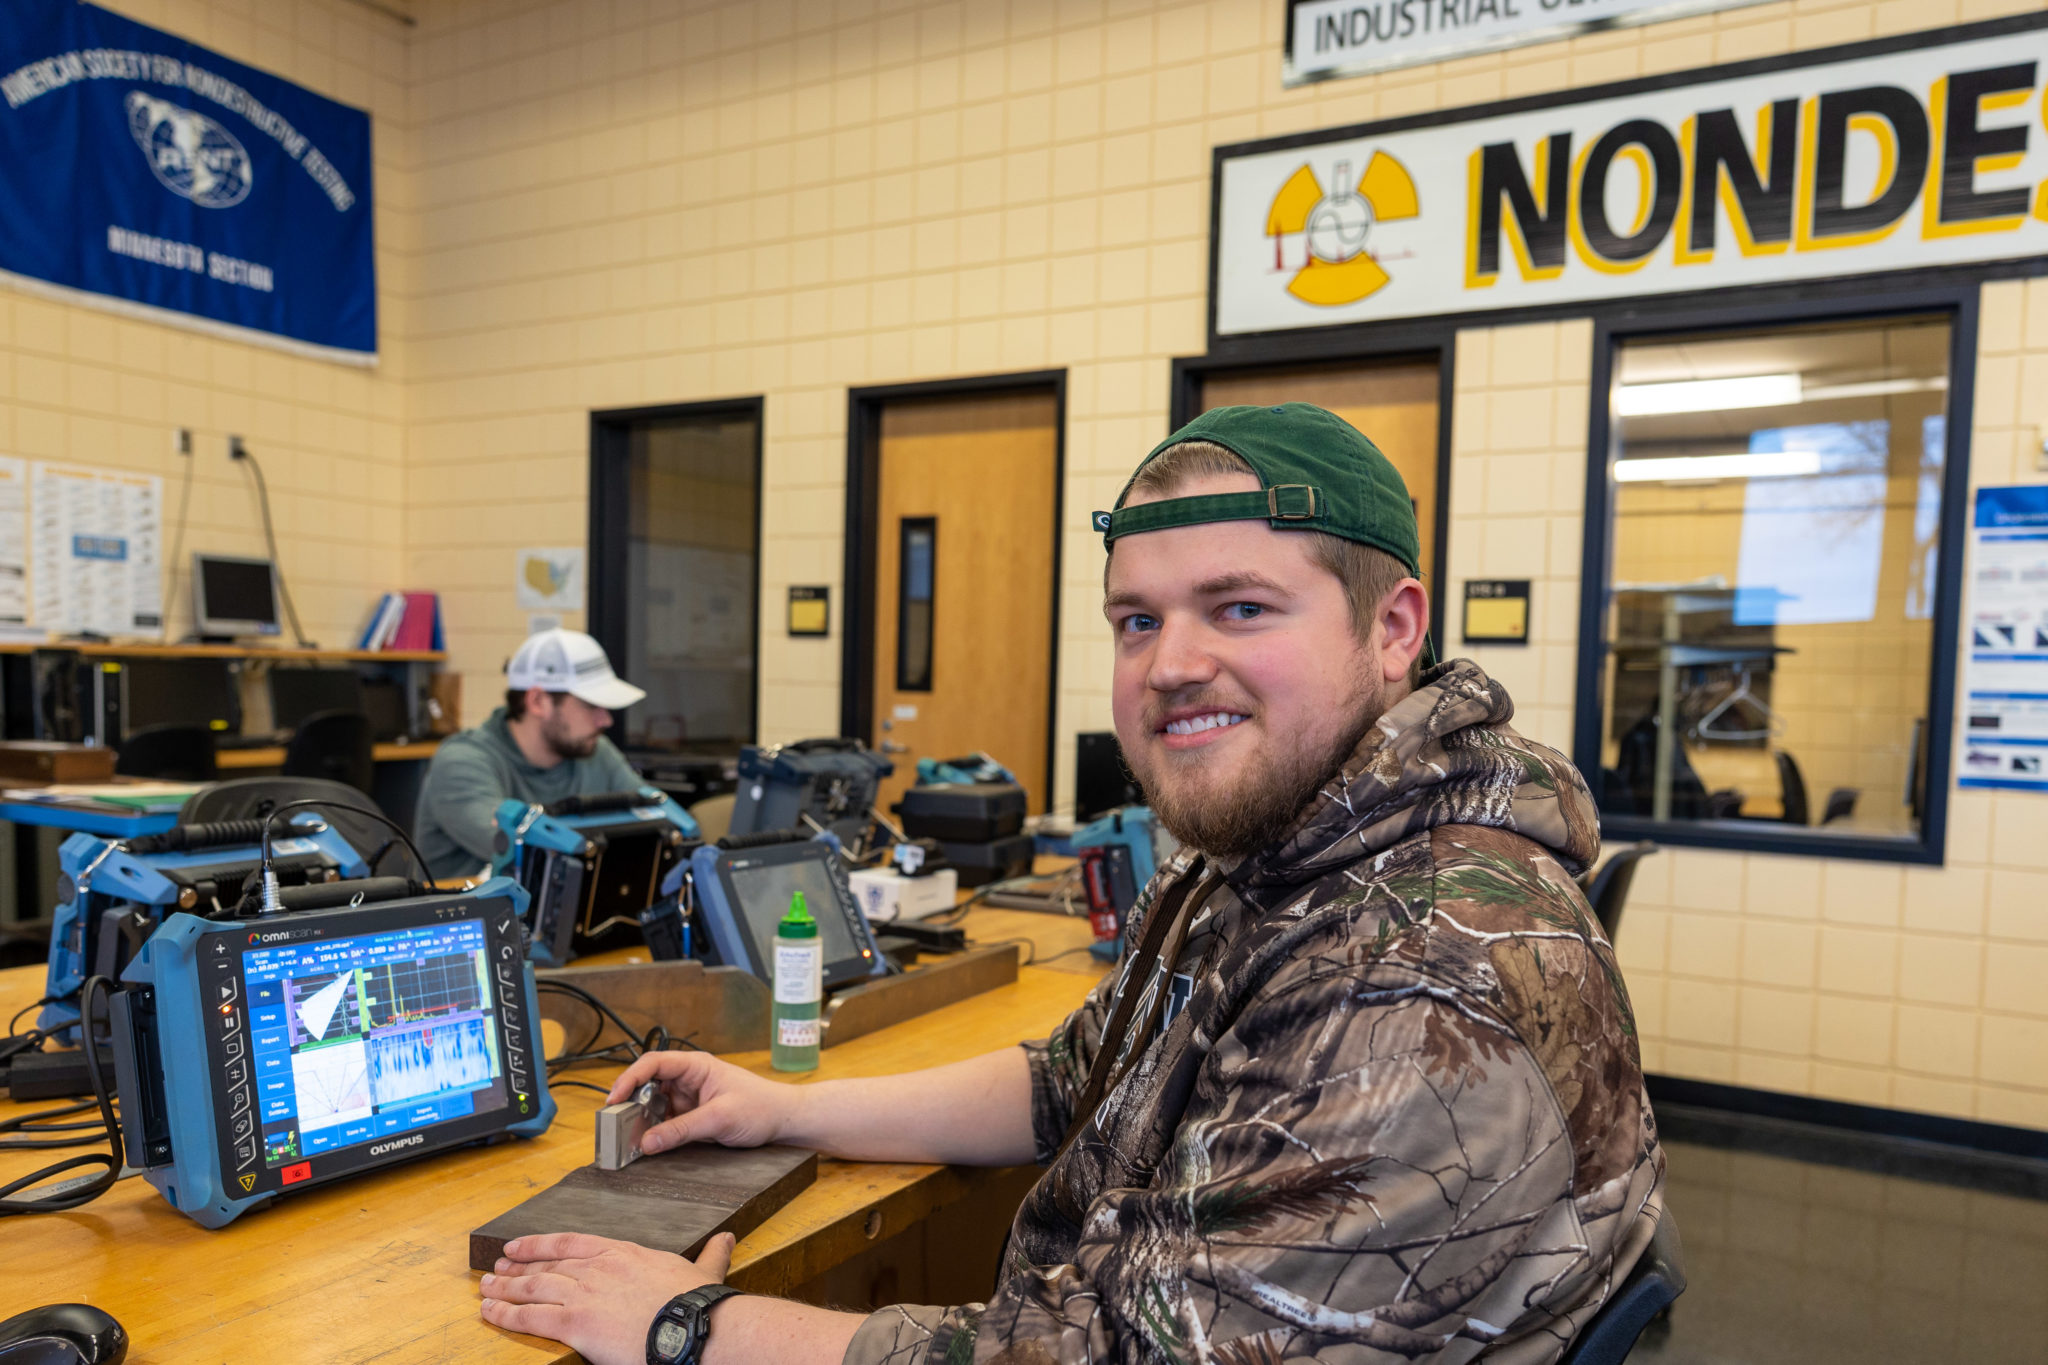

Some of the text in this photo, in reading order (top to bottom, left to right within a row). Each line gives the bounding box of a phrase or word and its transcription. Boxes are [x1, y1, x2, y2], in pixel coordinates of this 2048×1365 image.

[0, 48, 356, 212] AMERICAN SOCIETY FOR NONDESTRUCTIVE TESTING
[1465, 60, 2048, 289] NONDE
[107, 224, 274, 293] MINNESOTA SECTION
[369, 1133, 425, 1156] OLYMPUS
